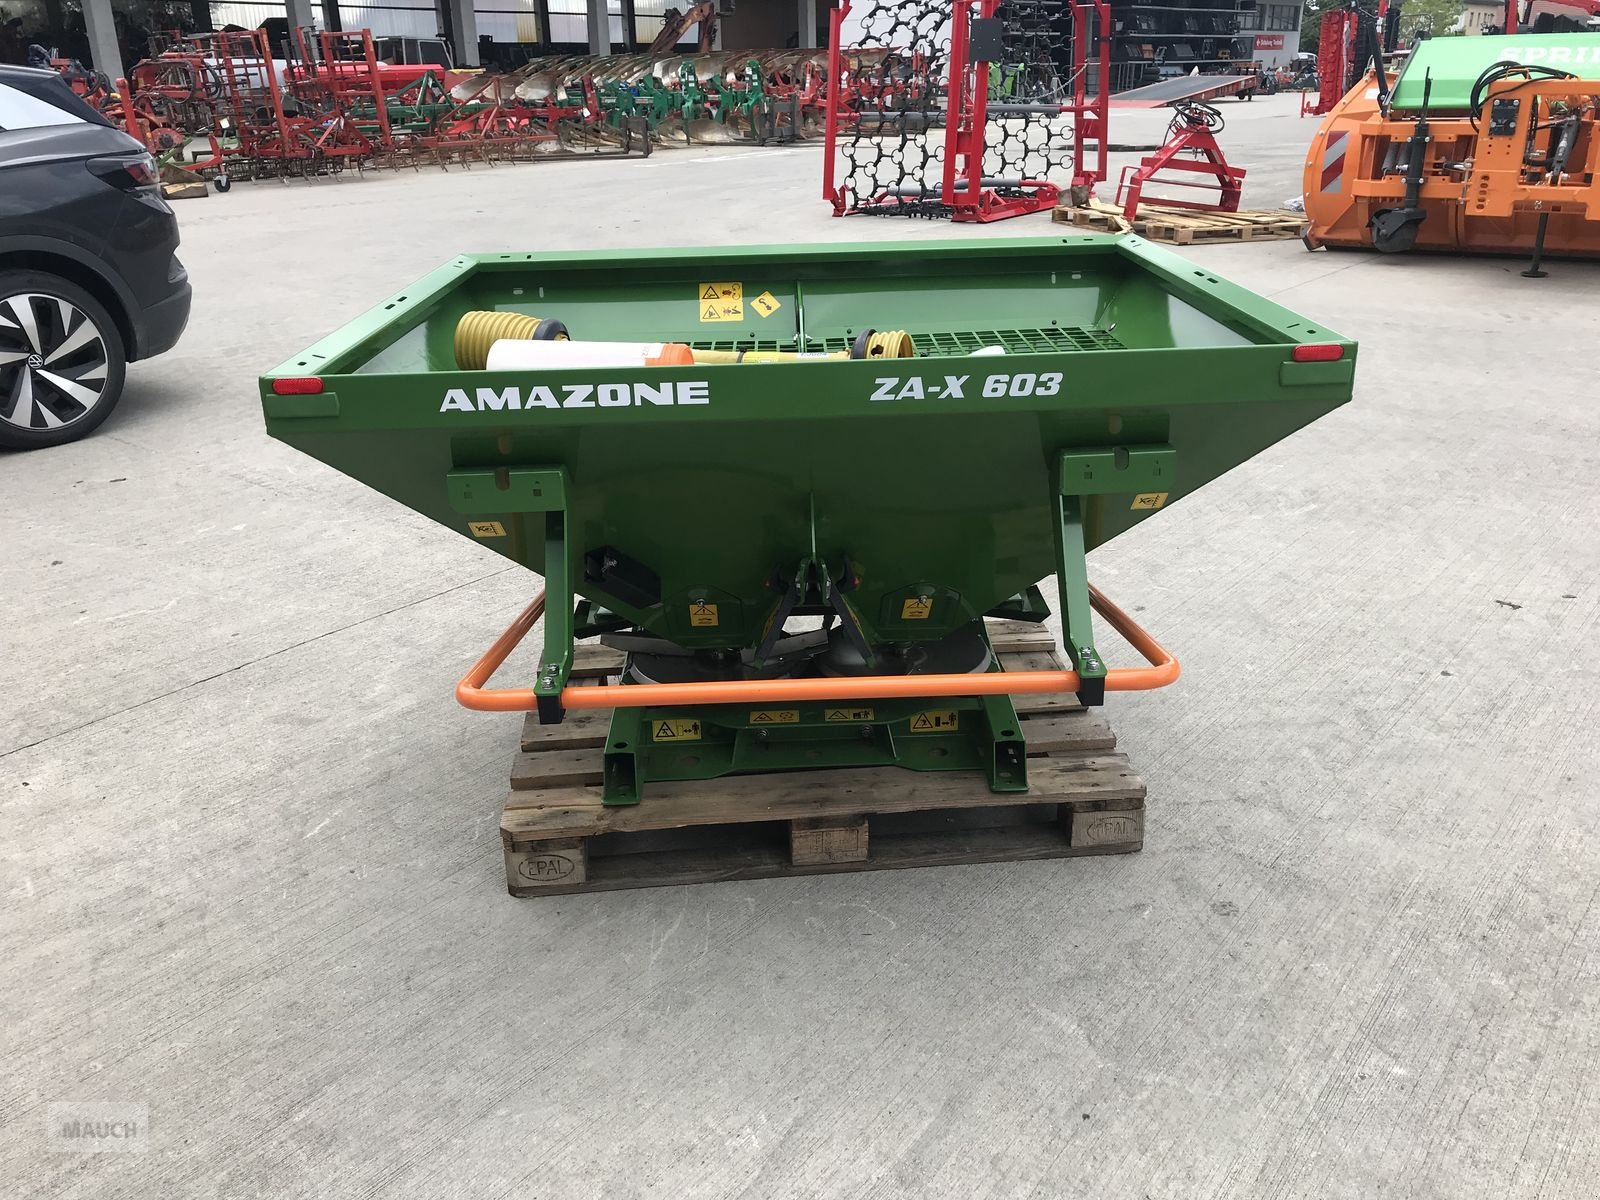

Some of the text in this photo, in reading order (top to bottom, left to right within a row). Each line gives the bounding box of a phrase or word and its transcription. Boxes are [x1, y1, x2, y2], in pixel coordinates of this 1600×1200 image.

[439, 381, 710, 413] AMAZONE
[869, 372, 1064, 401] ZA-X 603
[527, 860, 567, 876] EPAL
